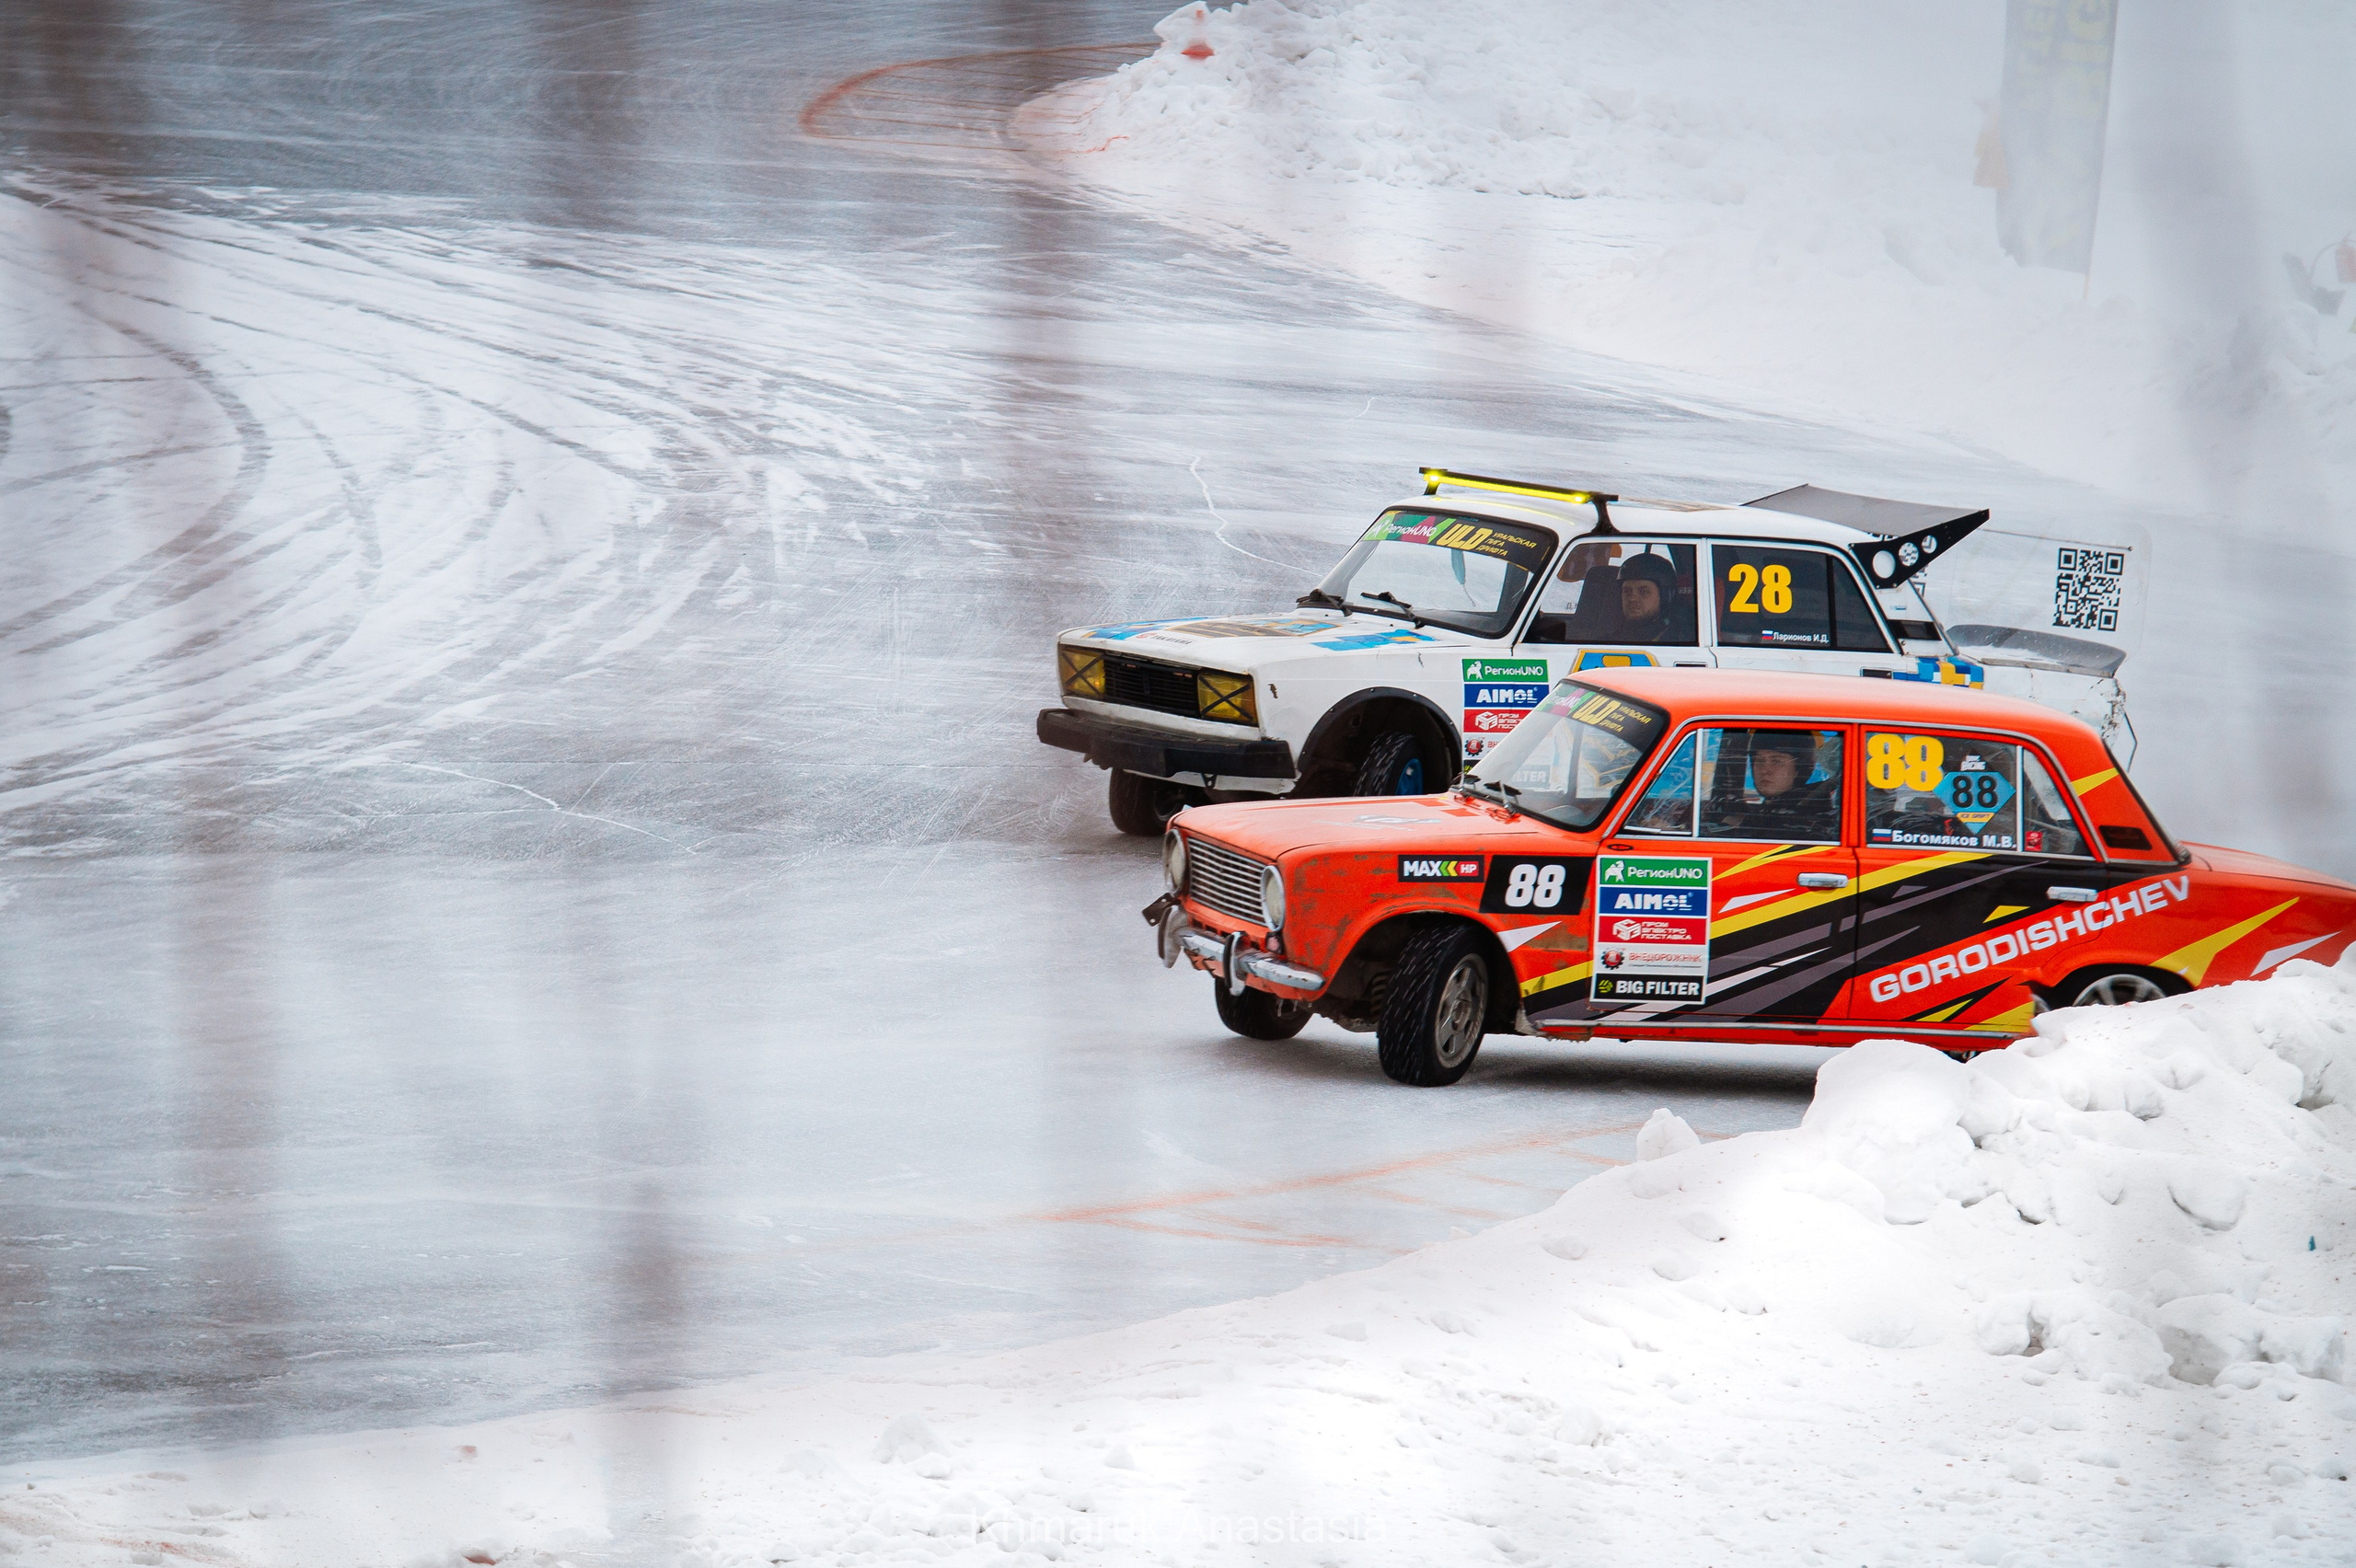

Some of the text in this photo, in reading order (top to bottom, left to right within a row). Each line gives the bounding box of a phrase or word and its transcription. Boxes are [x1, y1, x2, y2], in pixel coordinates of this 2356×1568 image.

[1436, 524, 1493, 550] ULD
[1493, 531, 1537, 549] УРАЛЬСКАЯ
[1728, 563, 1793, 614] 28
[1773, 631, 1812, 642] Ларионов
[1484, 665, 1544, 675] РегионUNO
[1866, 733, 1944, 791] 88
[1952, 775, 1998, 808] 88
[1891, 830, 1979, 847] Богомяков
[1403, 860, 1477, 877] MAX HP
[1627, 866, 1703, 879] РегионUNO
[1505, 863, 1566, 908] 88
[1869, 874, 2190, 1003] GORODISHCHEV
[1615, 980, 1701, 996] BIG FILTER
